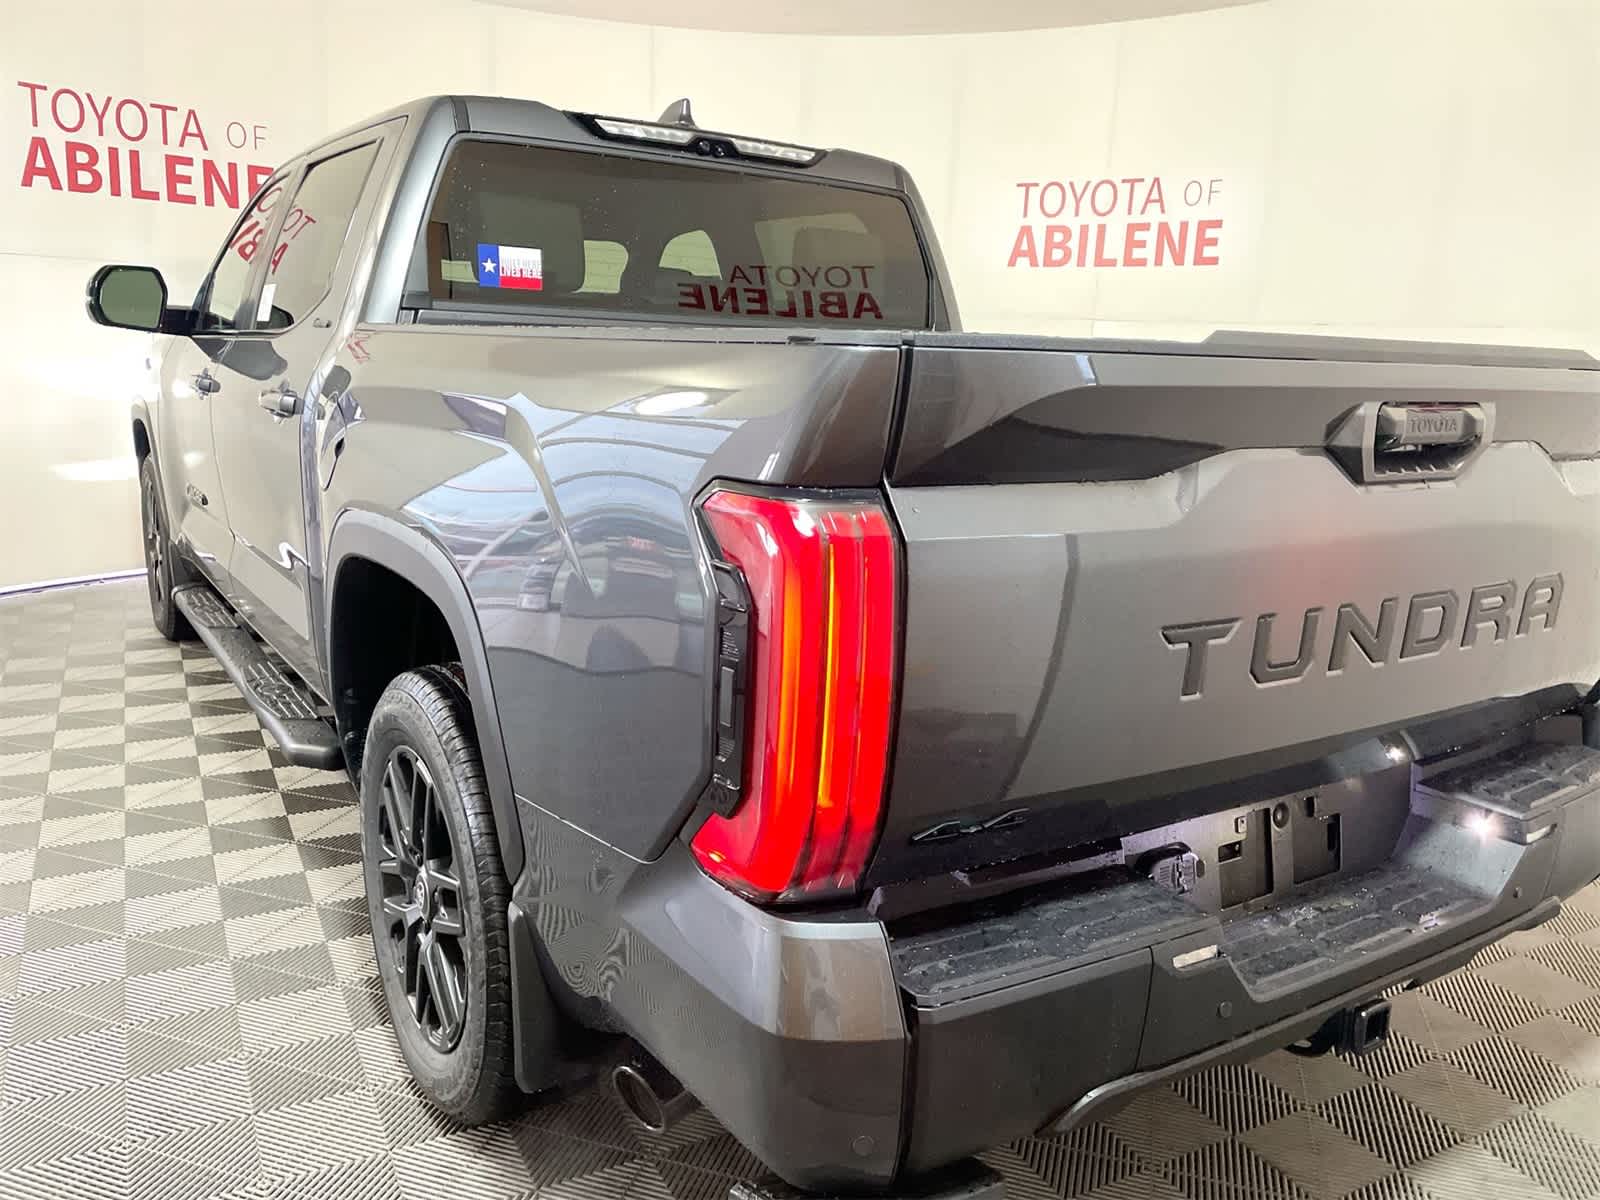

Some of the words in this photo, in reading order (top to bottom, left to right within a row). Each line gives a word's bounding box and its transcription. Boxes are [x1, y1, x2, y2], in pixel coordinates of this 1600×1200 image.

[17, 81, 208, 151] TOYOTA
[226, 121, 268, 150] OF
[1016, 176, 1166, 218] TOYOTA
[1183, 178, 1223, 207] OF
[1007, 219, 1224, 268] ABILENE
[1410, 418, 1458, 433] TOYOTA
[1160, 572, 1564, 701] TUNDRA
